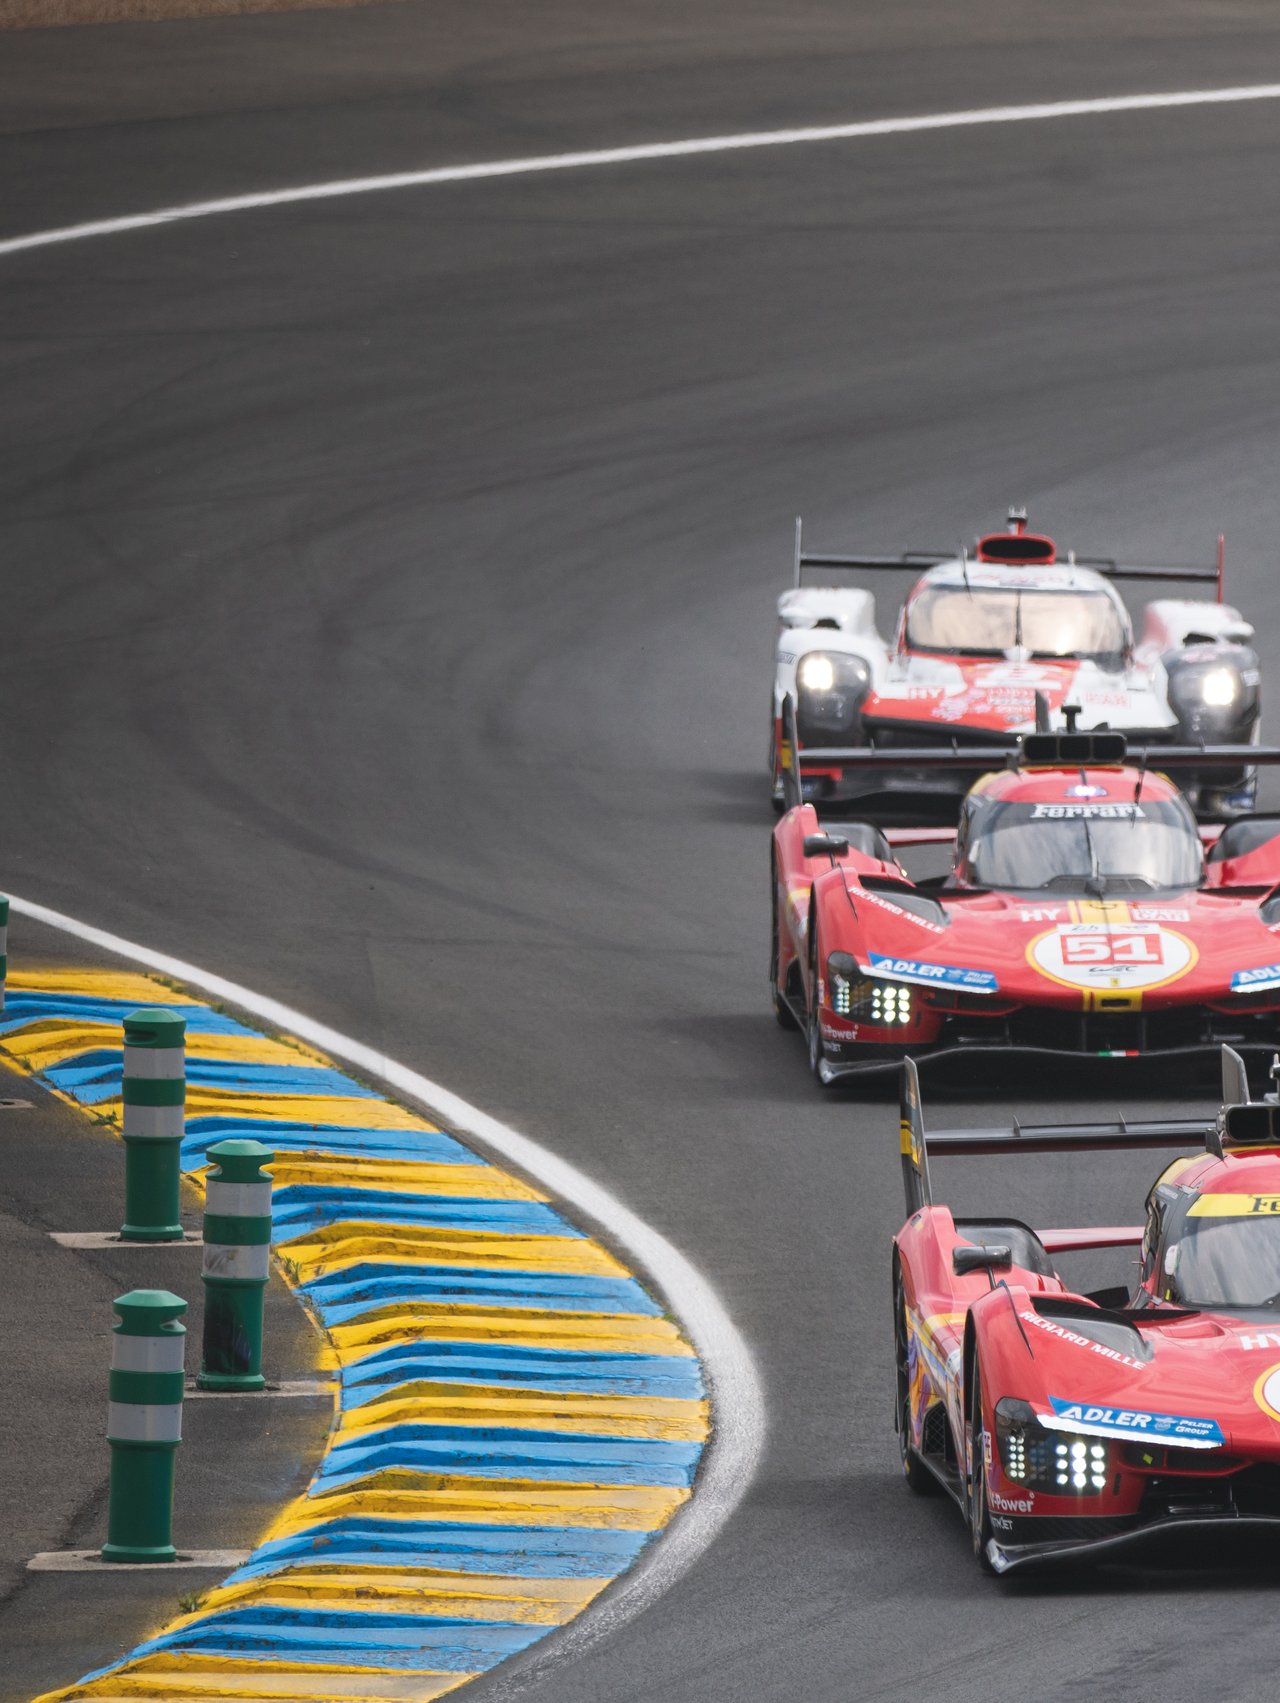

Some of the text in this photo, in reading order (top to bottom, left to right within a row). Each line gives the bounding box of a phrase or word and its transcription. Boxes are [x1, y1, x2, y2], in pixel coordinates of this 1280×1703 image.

[1030, 803, 1146, 818] Ferrari
[848, 886, 946, 935] RICHARD MILLE
[1020, 908, 1061, 922] HY
[1065, 935, 1159, 961] 51
[875, 959, 946, 978] ADLER
[1019, 1311, 1146, 1370] RICHARD MILLE
[1059, 1406, 1152, 1428] ADLER
[1180, 1420, 1214, 1430] PELZER
[1175, 1425, 1210, 1436] GROUP
